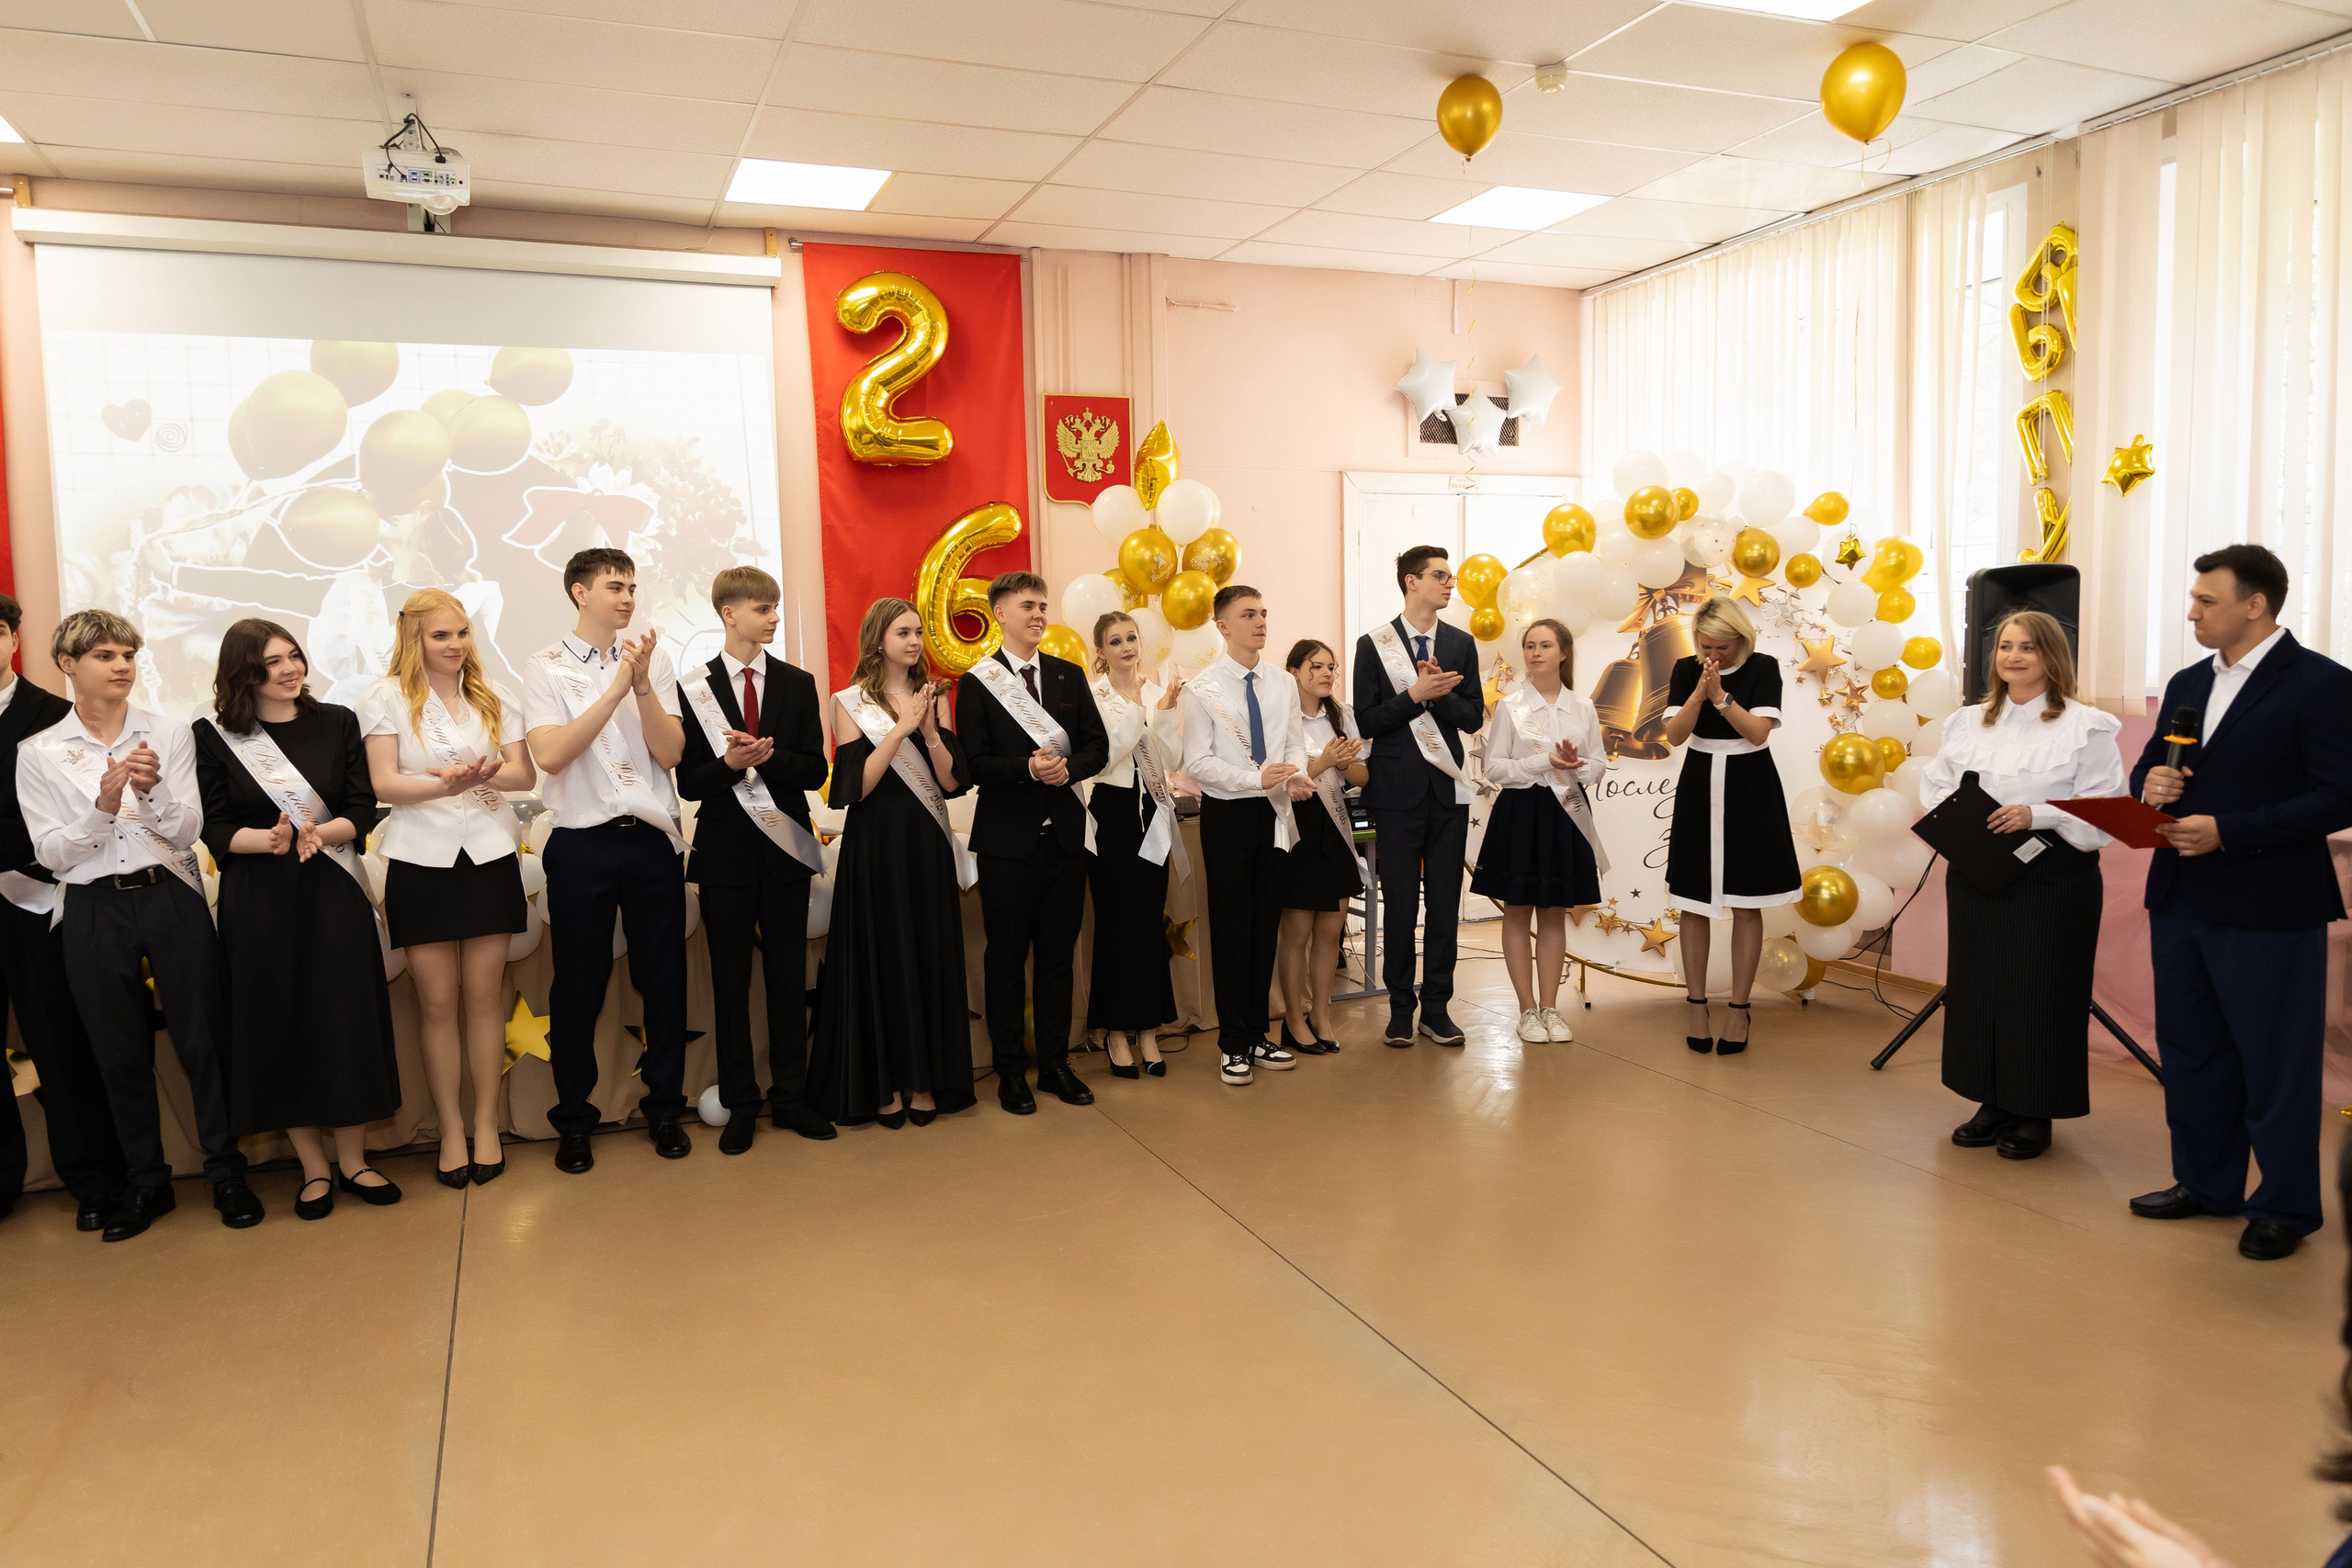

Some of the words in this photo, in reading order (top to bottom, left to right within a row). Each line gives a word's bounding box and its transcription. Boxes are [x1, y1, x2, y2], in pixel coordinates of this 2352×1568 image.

[835, 270, 955, 466] 2
[911, 501, 1023, 681] 6
[1420, 730, 1443, 753] 2026
[610, 761, 641, 786] 2026
[472, 786, 503, 812] 2026
[930, 791, 946, 816] 2026
[1566, 791, 1584, 813] 2026
[752, 805, 785, 828] 2026
[1335, 805, 1346, 826] 2026
